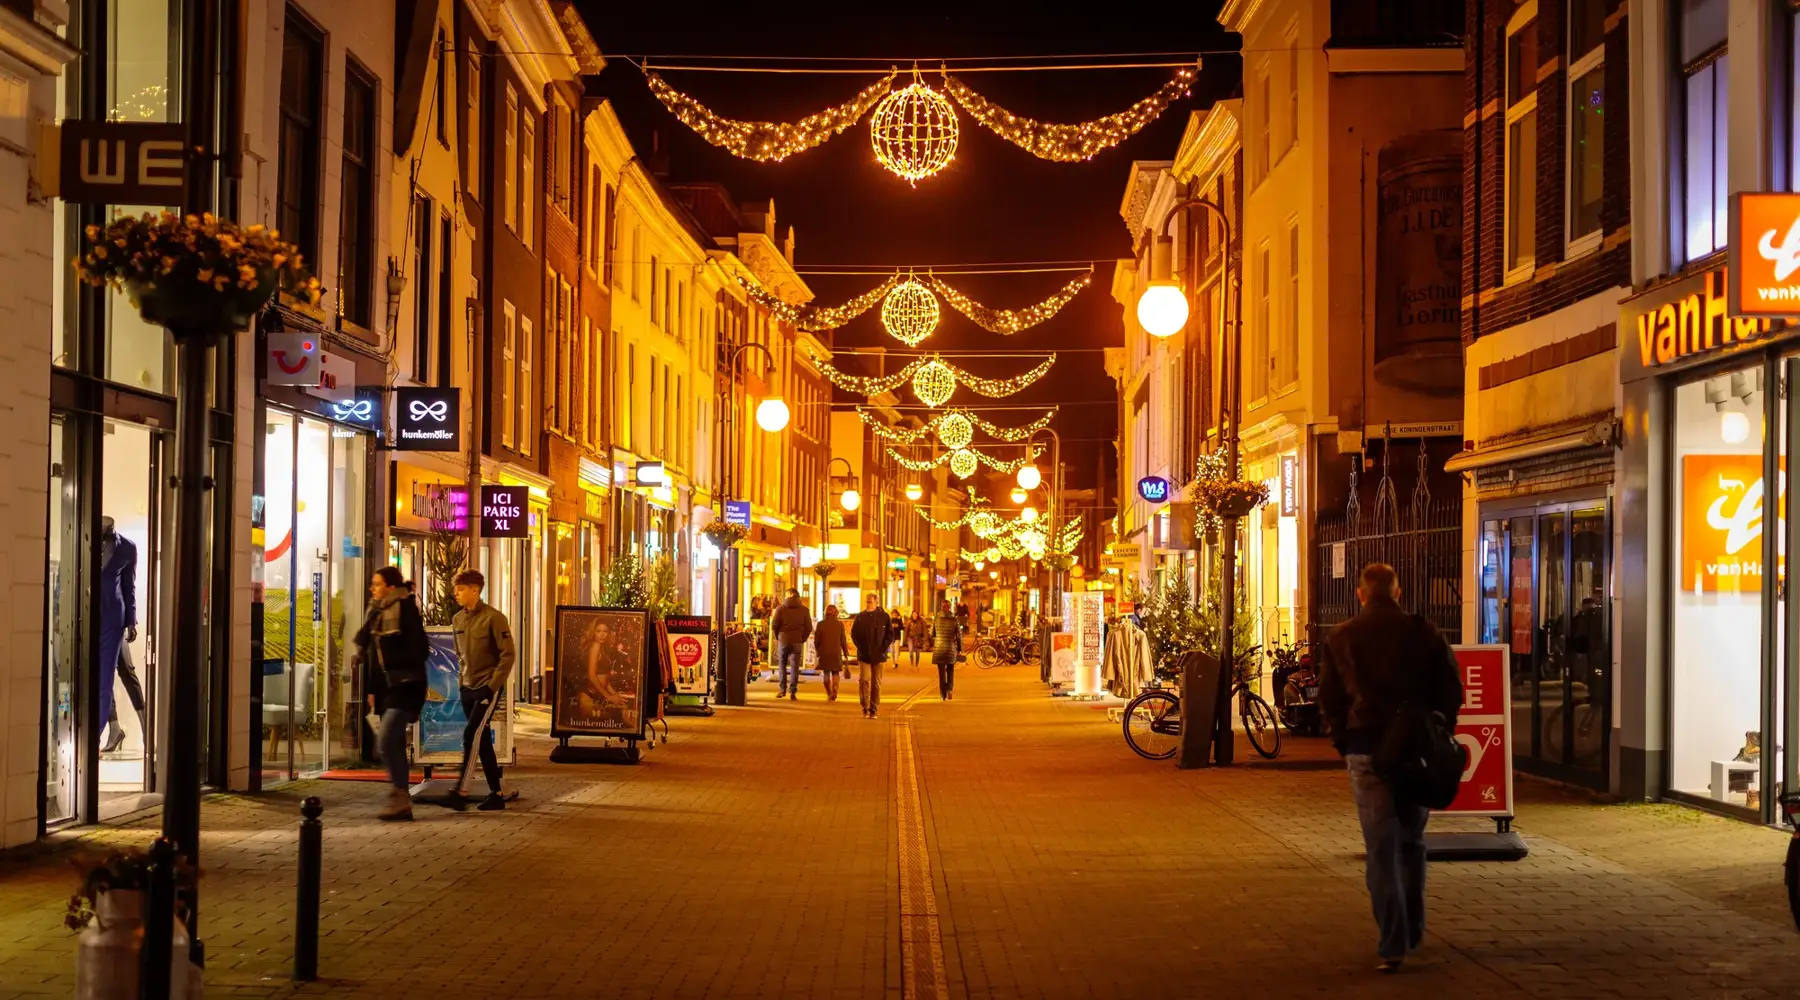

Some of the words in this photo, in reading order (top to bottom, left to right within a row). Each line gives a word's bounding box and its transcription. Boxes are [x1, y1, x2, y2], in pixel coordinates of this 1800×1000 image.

[80, 139, 183, 186] WE
[1400, 424, 1455, 433] KONINGENSTRAAT
[402, 429, 454, 440] hunkemöller
[493, 493, 512, 505] ICI
[483, 506, 520, 518] PARIS
[494, 519, 511, 531] XL
[675, 643, 698, 652] 40%
[570, 717, 624, 728] hunkemöller
